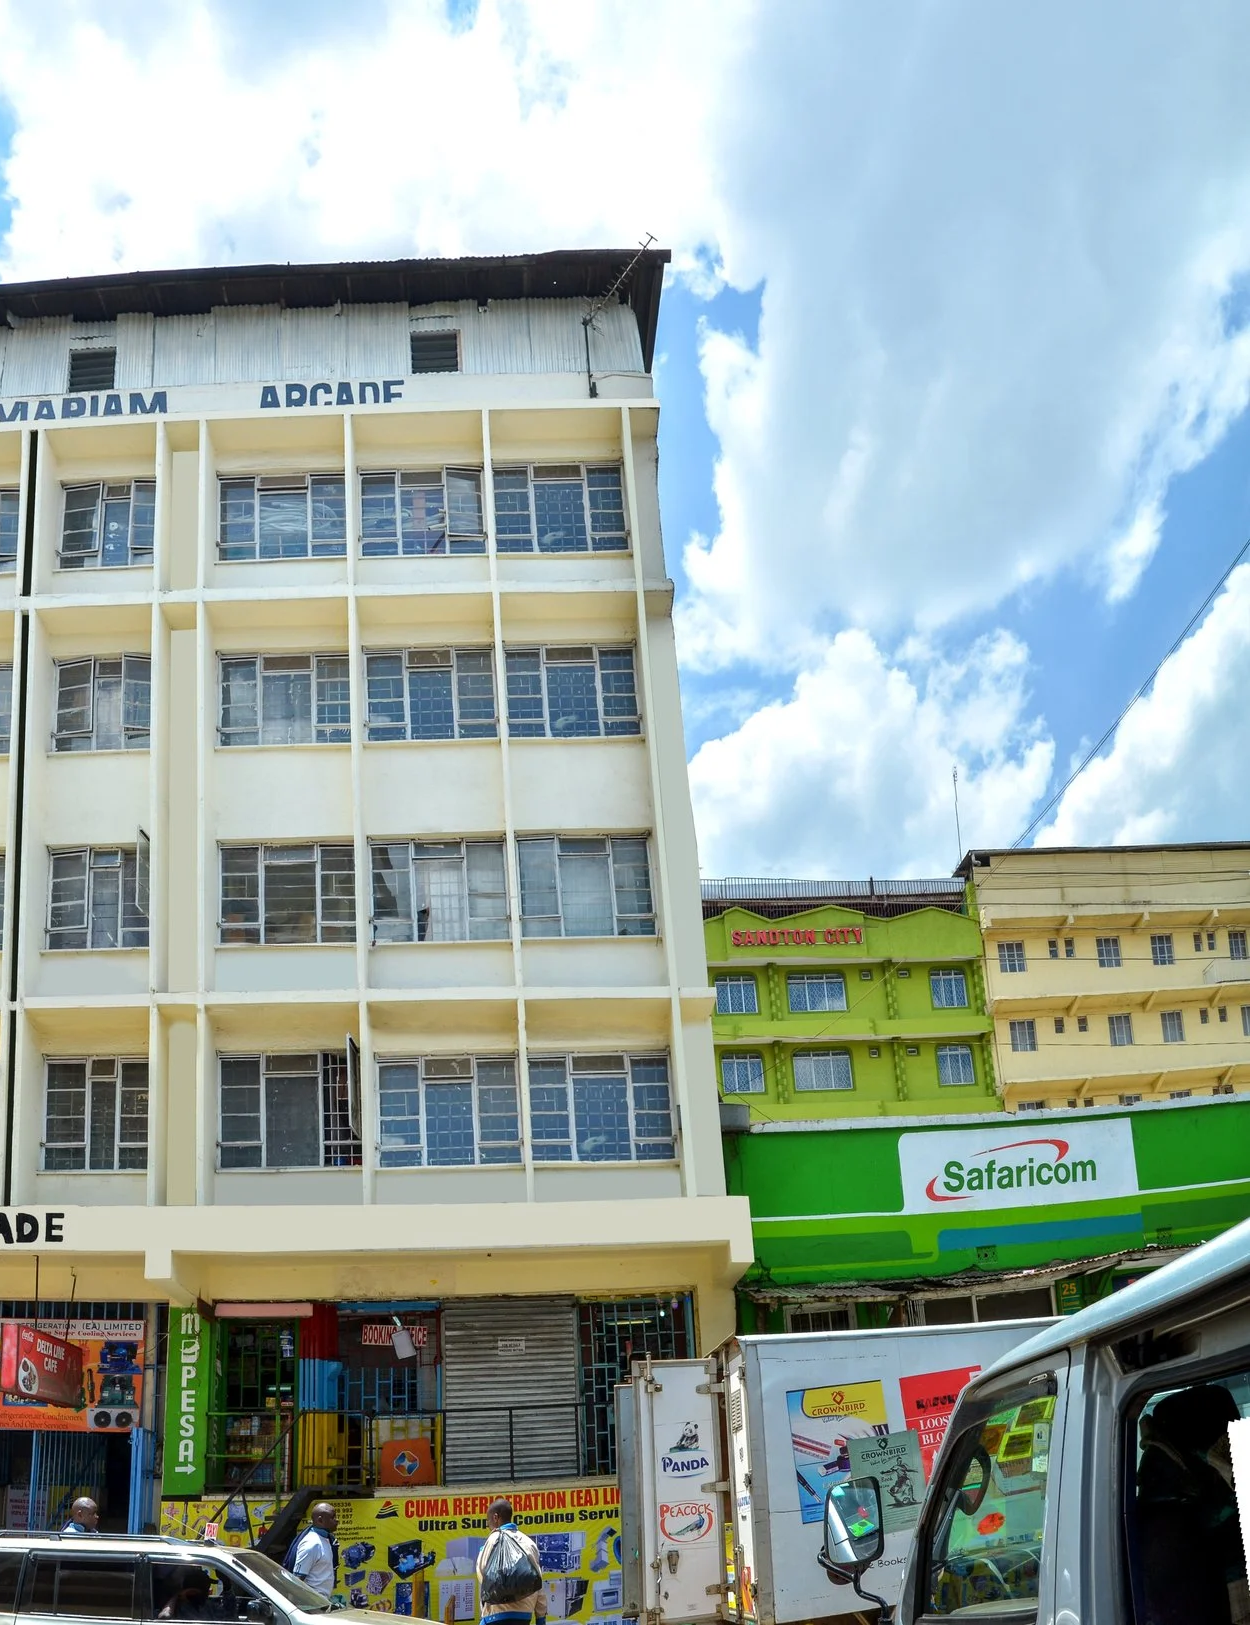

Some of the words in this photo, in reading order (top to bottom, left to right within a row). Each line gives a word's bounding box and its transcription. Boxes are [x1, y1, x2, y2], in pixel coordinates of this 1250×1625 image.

[732, 928, 817, 946] SANDTON
[824, 926, 864, 944] CITY
[943, 1156, 1097, 1192] Safaricom
[1062, 1282, 1077, 1295] 25
[78, 1330, 105, 1338] Cooling
[82, 1322, 101, 1331] (EA)
[104, 1322, 142, 1331] LIMITED
[37, 1338, 53, 1356] DELTA
[43, 1357, 58, 1373] CAFE
[811, 1402, 865, 1417] CROWNBIRD
[12, 1420, 23, 1428] And
[25, 1420, 42, 1428] Other
[44, 1421, 69, 1429] Services
[861, 1446, 906, 1460] CROWNBIRD
[661, 1456, 710, 1473] PANDA
[404, 1498, 450, 1518] CUMA
[570, 1488, 599, 1508] (EA)
[659, 1503, 714, 1518] PEACOCK
[418, 1520, 457, 1532] Ultra
[513, 1511, 575, 1526] Cooling
[578, 1508, 619, 1521] Servi
[206, 1523, 218, 1537] TAXI
